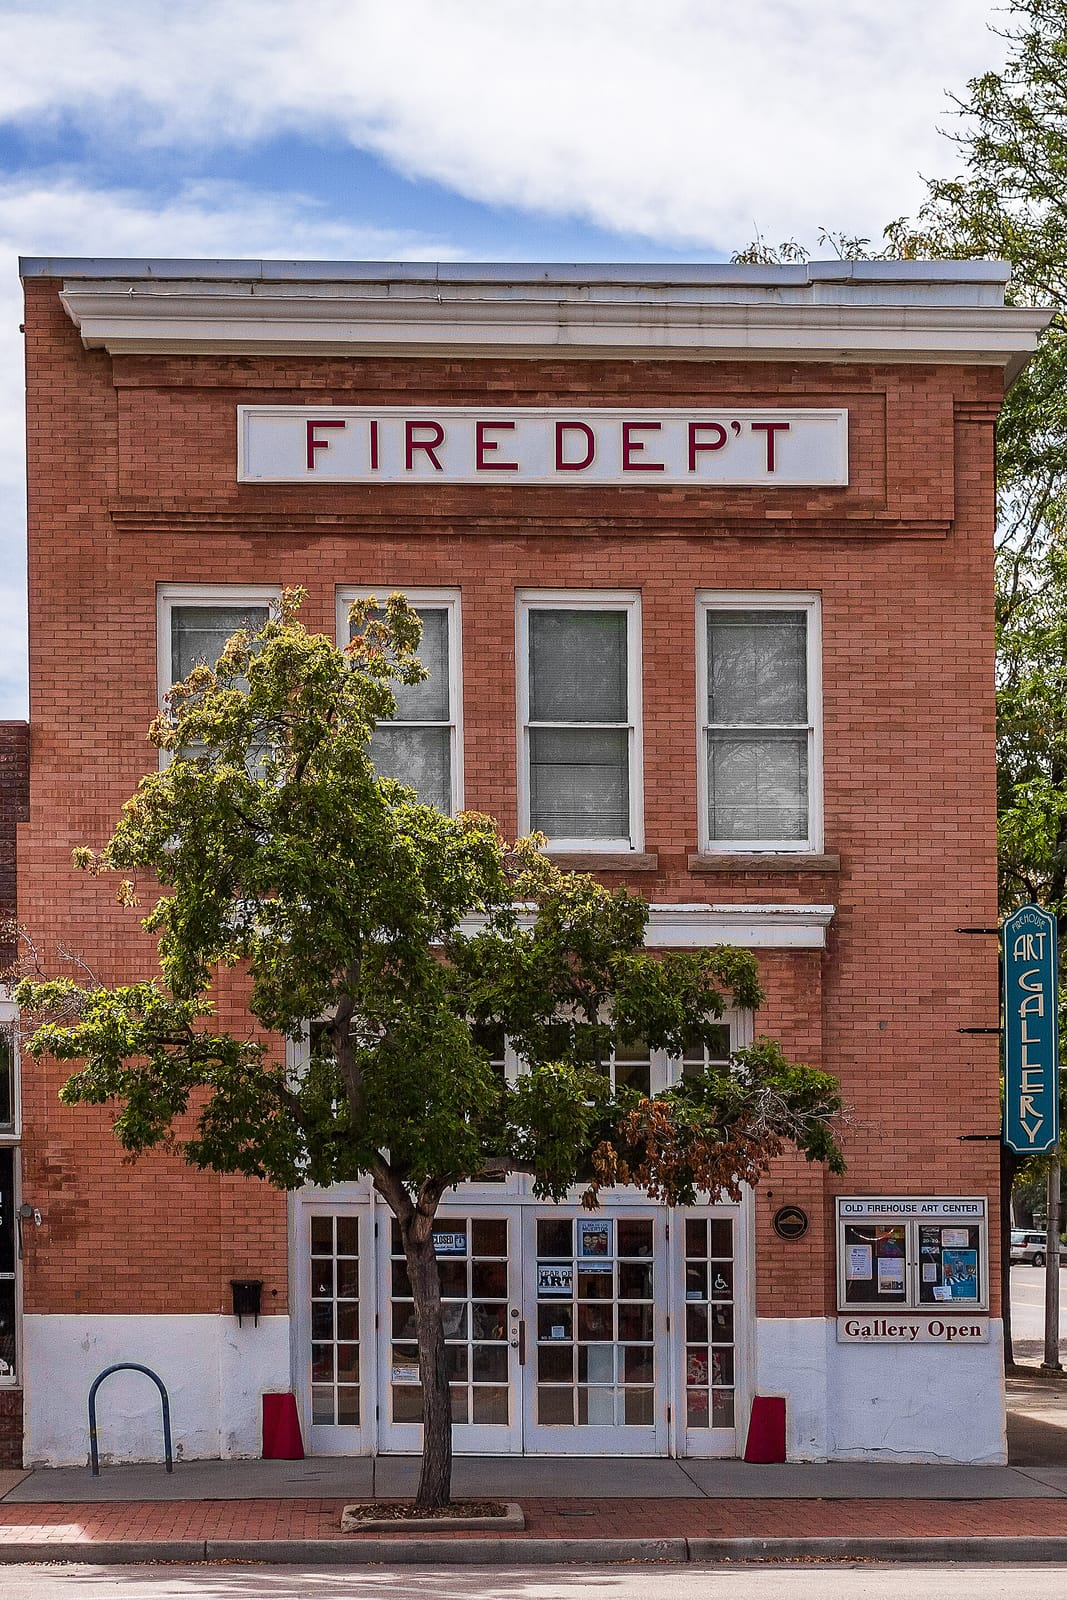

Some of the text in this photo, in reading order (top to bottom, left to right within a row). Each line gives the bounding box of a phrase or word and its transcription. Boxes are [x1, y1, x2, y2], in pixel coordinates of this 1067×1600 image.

[306, 420, 790, 472] FIRE DEP'T
[1011, 913, 1046, 933] FIREHOUSE
[1013, 932, 1047, 962] ART
[1018, 968, 1045, 1144] GALLERY
[845, 1204, 978, 1213] OLD FIREHOUSE ART CENTER
[539, 1276, 573, 1287] ART
[845, 1319, 982, 1341] Gallery Open
